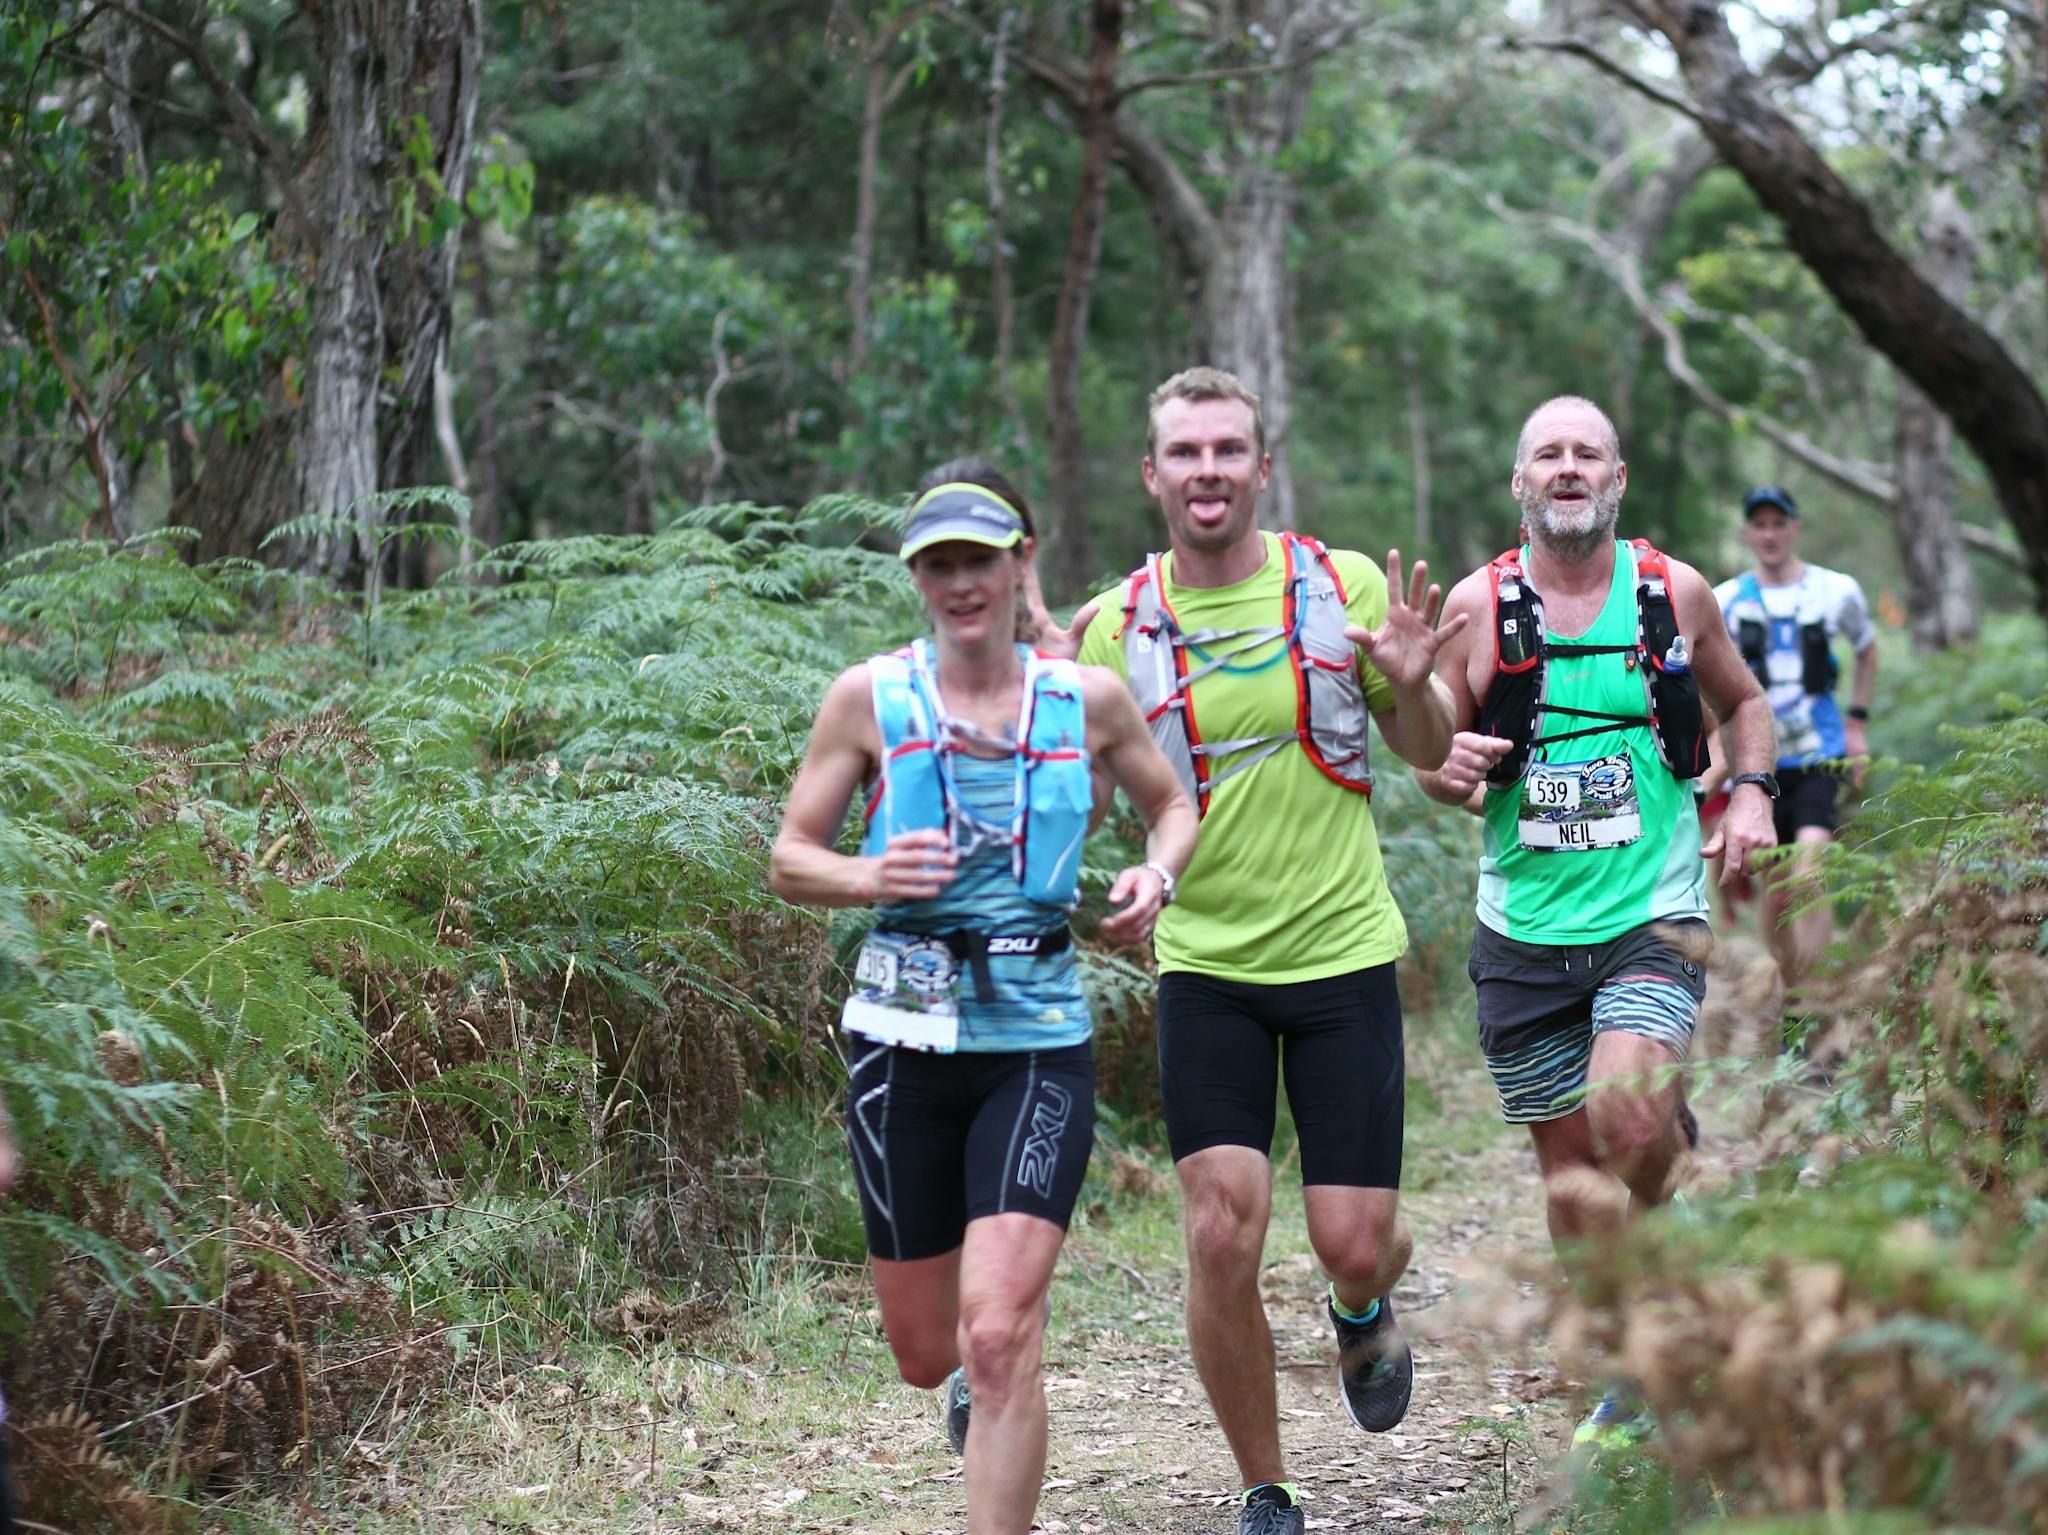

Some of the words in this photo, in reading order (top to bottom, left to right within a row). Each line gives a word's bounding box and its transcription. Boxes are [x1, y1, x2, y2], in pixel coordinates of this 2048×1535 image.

[1582, 760, 1605, 778] Two
[1605, 755, 1631, 771] Bays
[1537, 781, 1568, 803] 539
[1585, 787, 1613, 799] Trail
[1559, 823, 1596, 844] NEIL
[987, 937, 1040, 953] 2XU
[1017, 1080, 1072, 1199] 2XU
